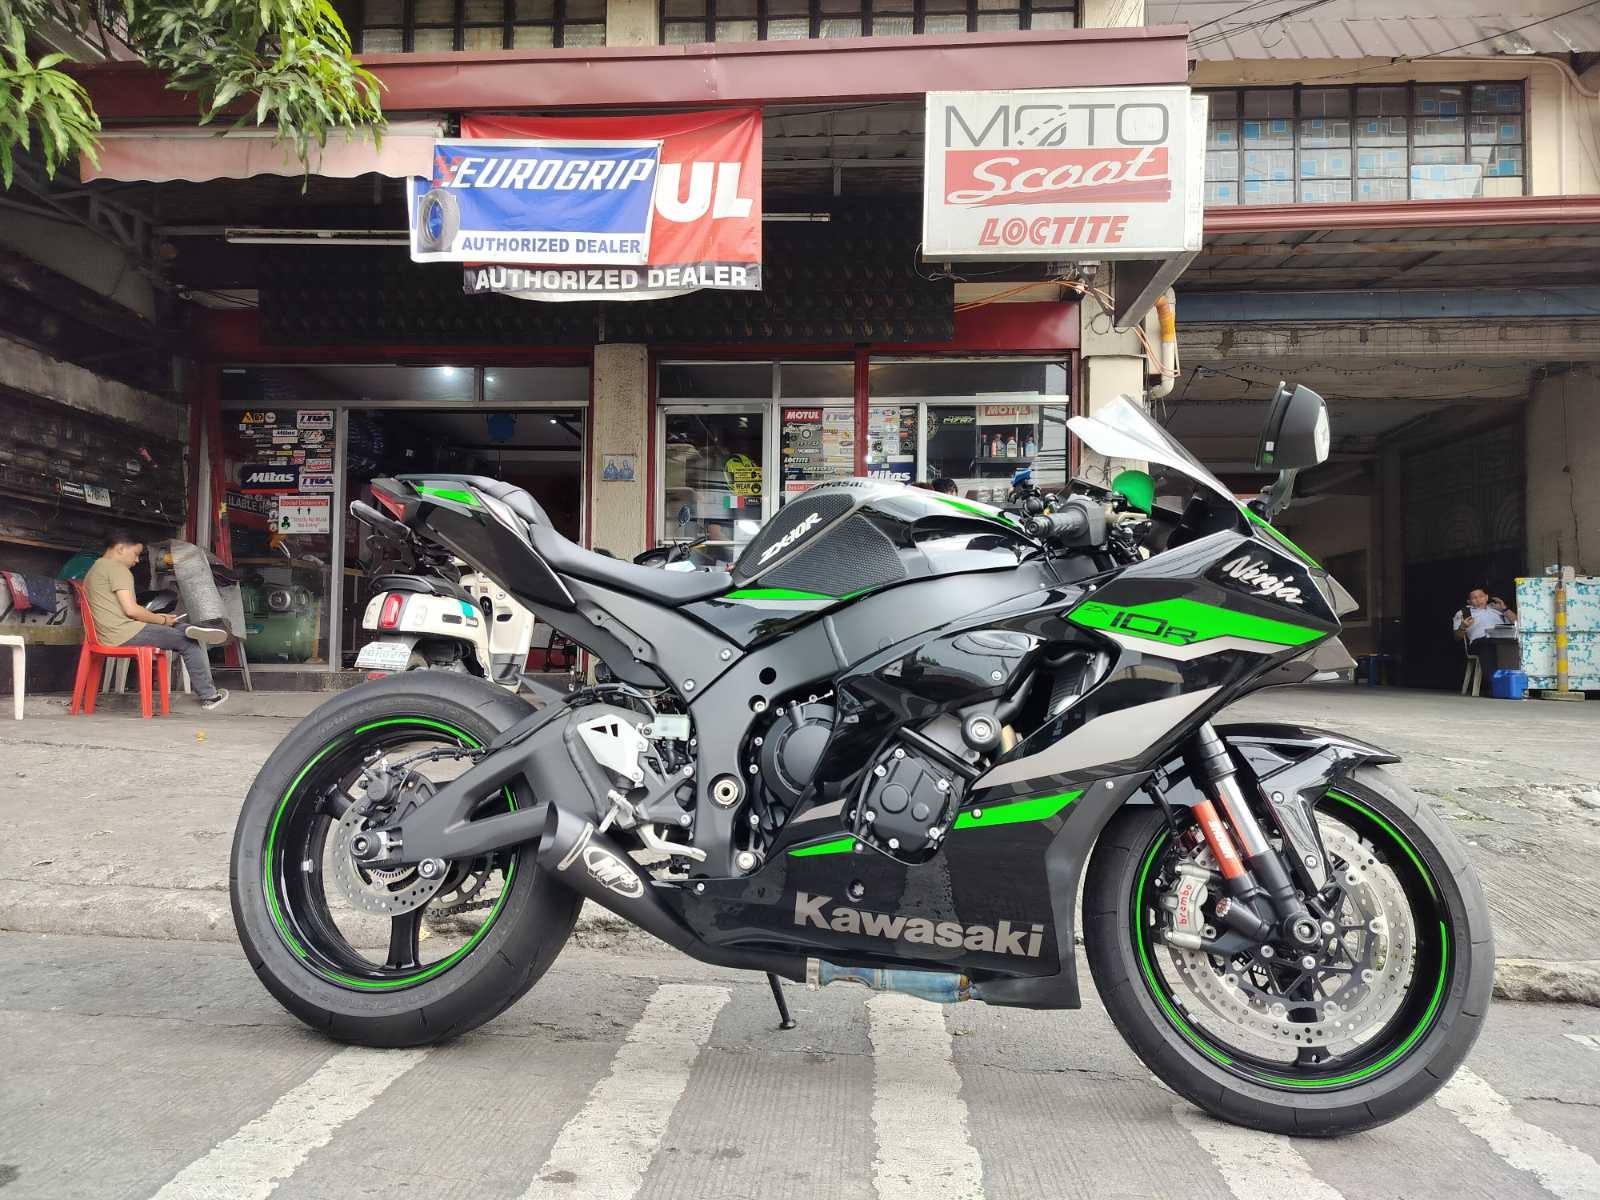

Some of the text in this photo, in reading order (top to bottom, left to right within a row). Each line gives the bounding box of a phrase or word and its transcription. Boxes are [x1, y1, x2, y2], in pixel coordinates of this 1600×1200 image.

[945, 103, 1169, 147] MOTO
[450, 157, 652, 191] EUROGRIP
[947, 147, 1172, 204] Scoot
[461, 236, 642, 255] AUTHORIZED DEALER
[978, 215, 1130, 246] LOCTITE
[474, 265, 749, 291] AUTHORIZED DEALER
[787, 411, 820, 420] MOTUL
[246, 471, 295, 483] Mitas
[1222, 555, 1304, 604] Ninja
[1110, 610, 1198, 644] 10R
[1179, 884, 1193, 927] brembo
[794, 891, 1044, 958] Kawasaki
